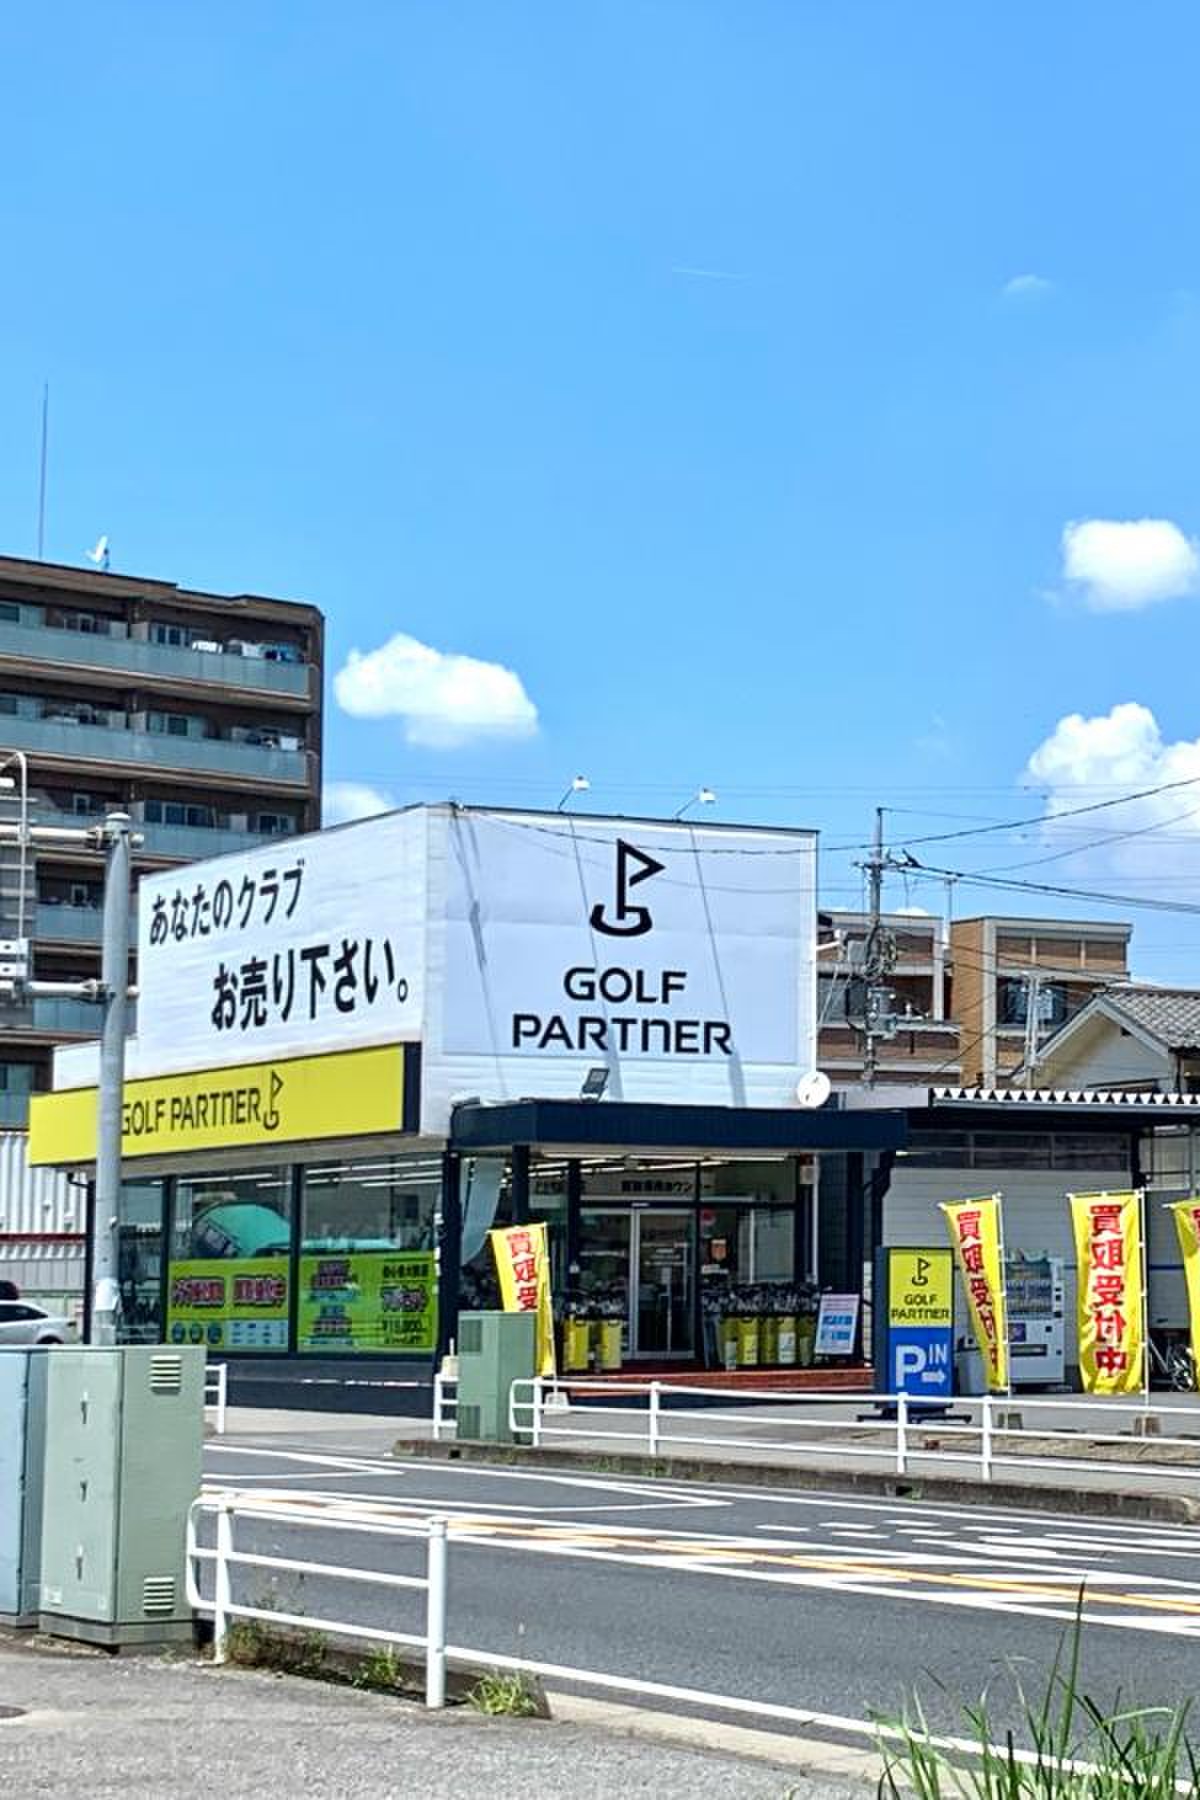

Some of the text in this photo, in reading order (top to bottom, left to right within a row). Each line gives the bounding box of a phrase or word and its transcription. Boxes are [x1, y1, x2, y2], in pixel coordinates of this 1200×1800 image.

[150, 859, 305, 945] あなたのクラブ
[211, 939, 409, 1031] お売り下さい。
[564, 967, 687, 1004] GOLF
[512, 1014, 733, 1054] PARTNER
[121, 1087, 261, 1136] GOLF PARTNER
[904, 1294, 938, 1306] GOLF
[1090, 1205, 1127, 1377] 買取受付中
[892, 1308, 949, 1320] PARTNER
[896, 1345, 927, 1388] P
[929, 1343, 947, 1365] IN
